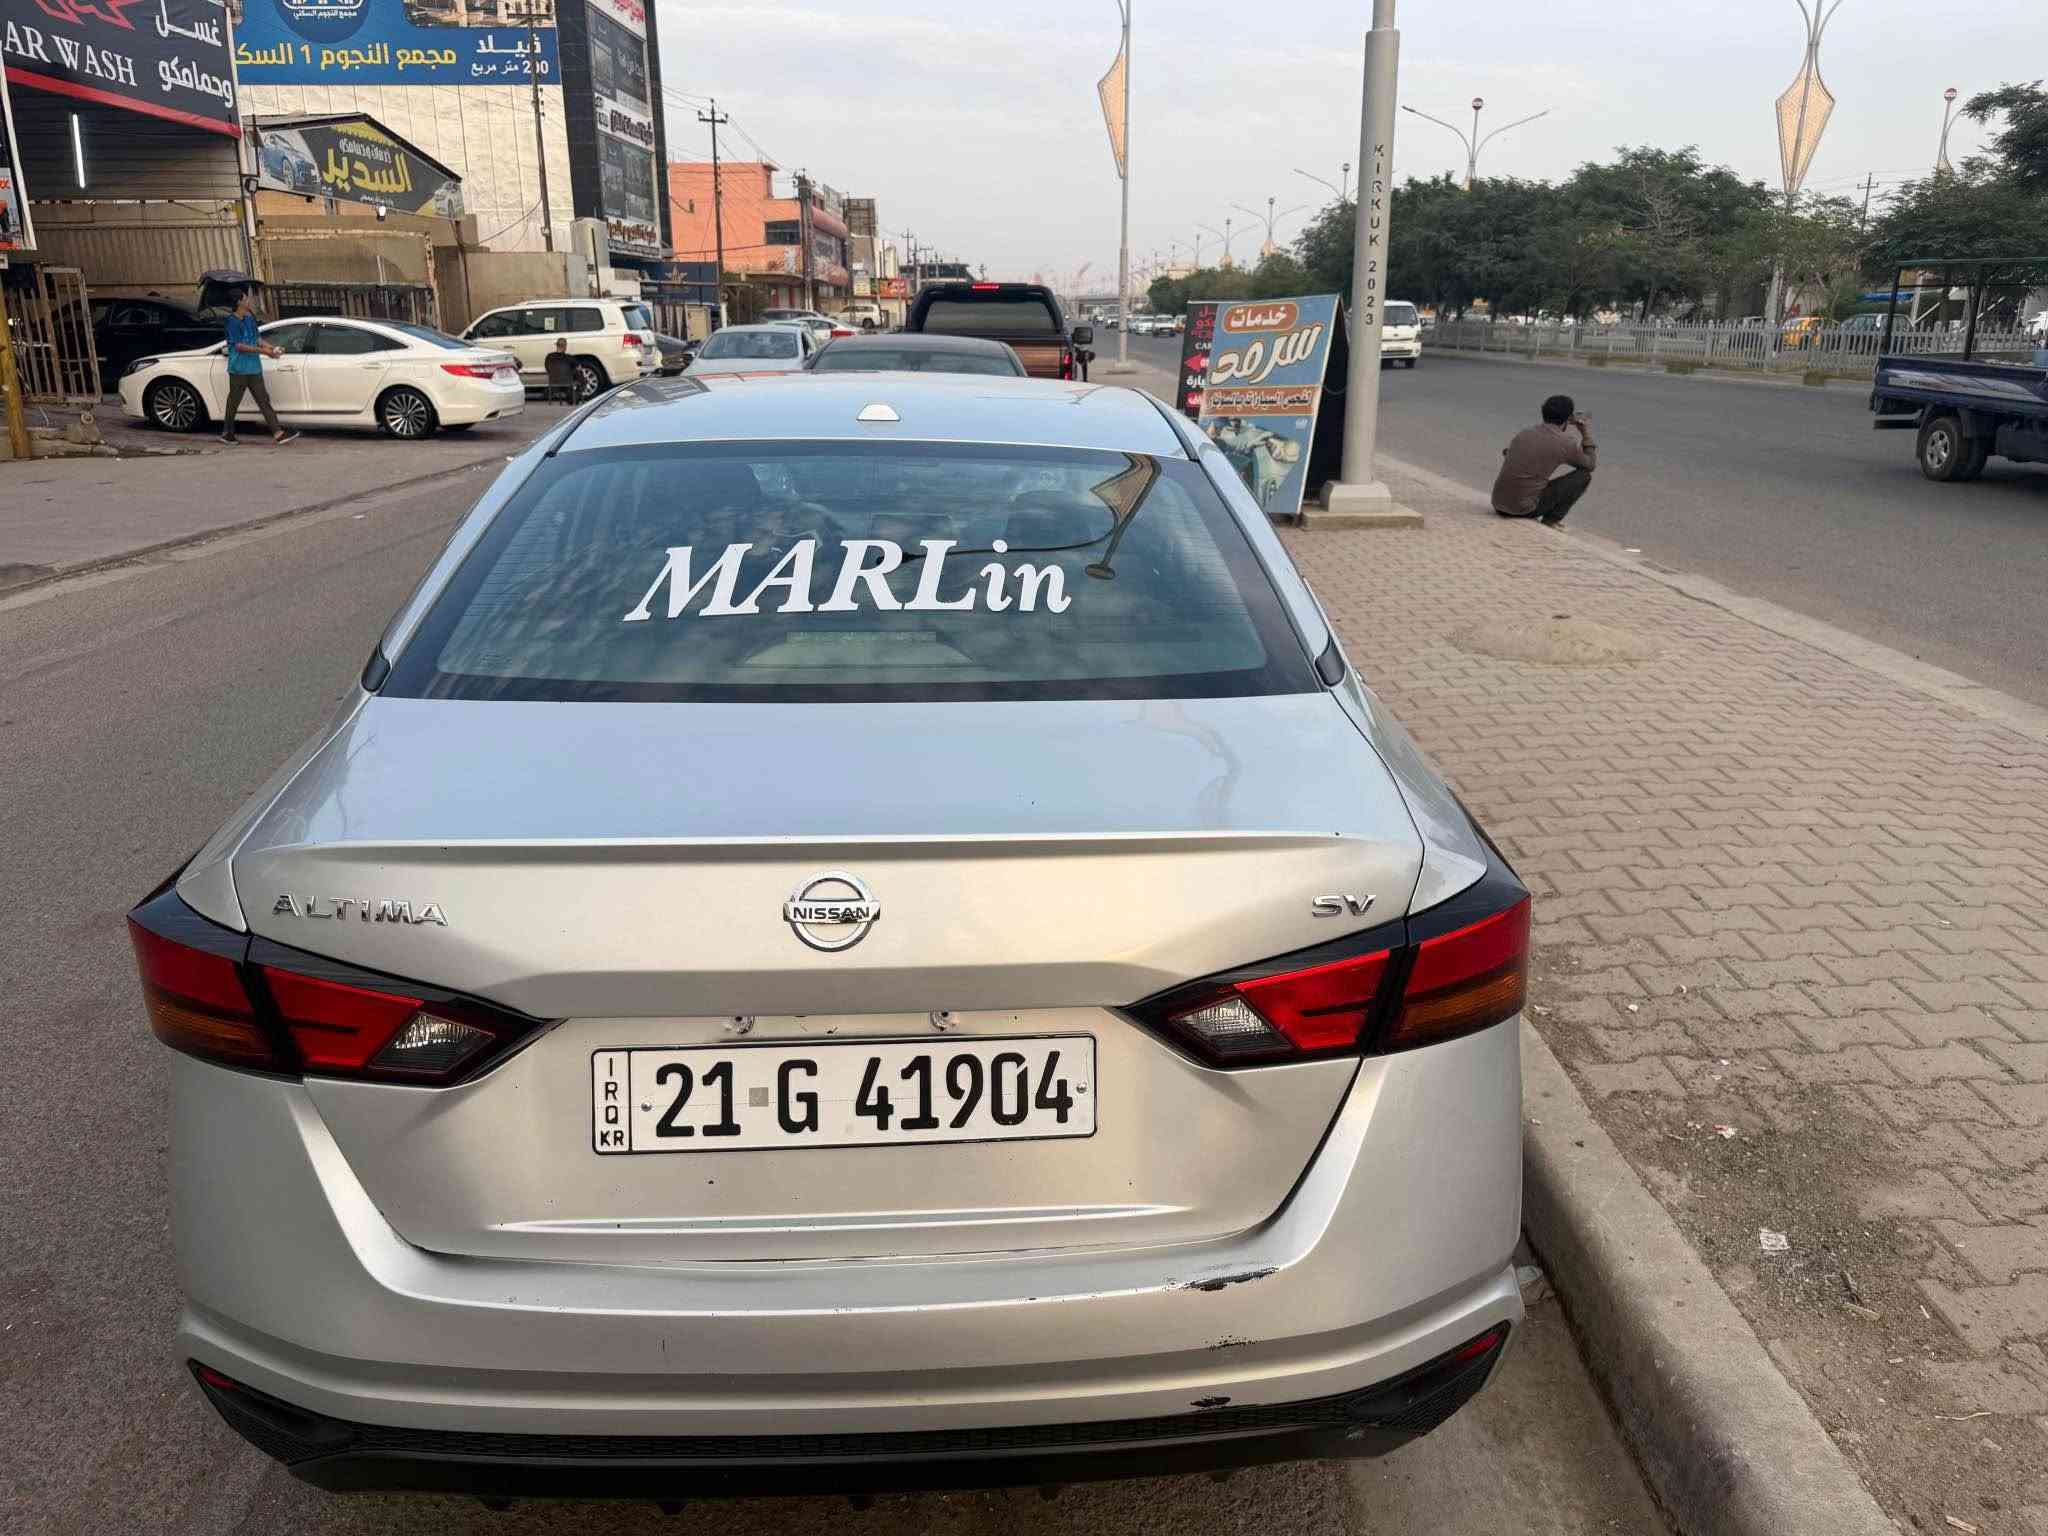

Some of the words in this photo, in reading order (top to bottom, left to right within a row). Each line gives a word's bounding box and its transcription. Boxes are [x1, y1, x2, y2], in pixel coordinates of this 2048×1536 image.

[0, 20, 51, 63] AR
[51, 35, 137, 87] WASH
[300, 44, 312, 64] 1
[320, 42, 390, 70] النجوم
[395, 47, 457, 70] مجمع
[471, 61, 496, 76] مربع
[501, 61, 519, 75] متر
[1369, 144, 1385, 246] KIRKUK
[1365, 260, 1377, 326] 2023
[1230, 306, 1287, 328] خدمات
[1209, 325, 1323, 385] سرمد
[622, 539, 1072, 622] MARLin
[272, 894, 449, 927] ALTIMA
[793, 906, 870, 920] NISSAN
[1311, 894, 1377, 918] SV
[655, 1060, 741, 1138] 21
[777, 1058, 819, 1134] G
[855, 1050, 1073, 1131] 41904
[600, 1129, 625, 1147] KR
